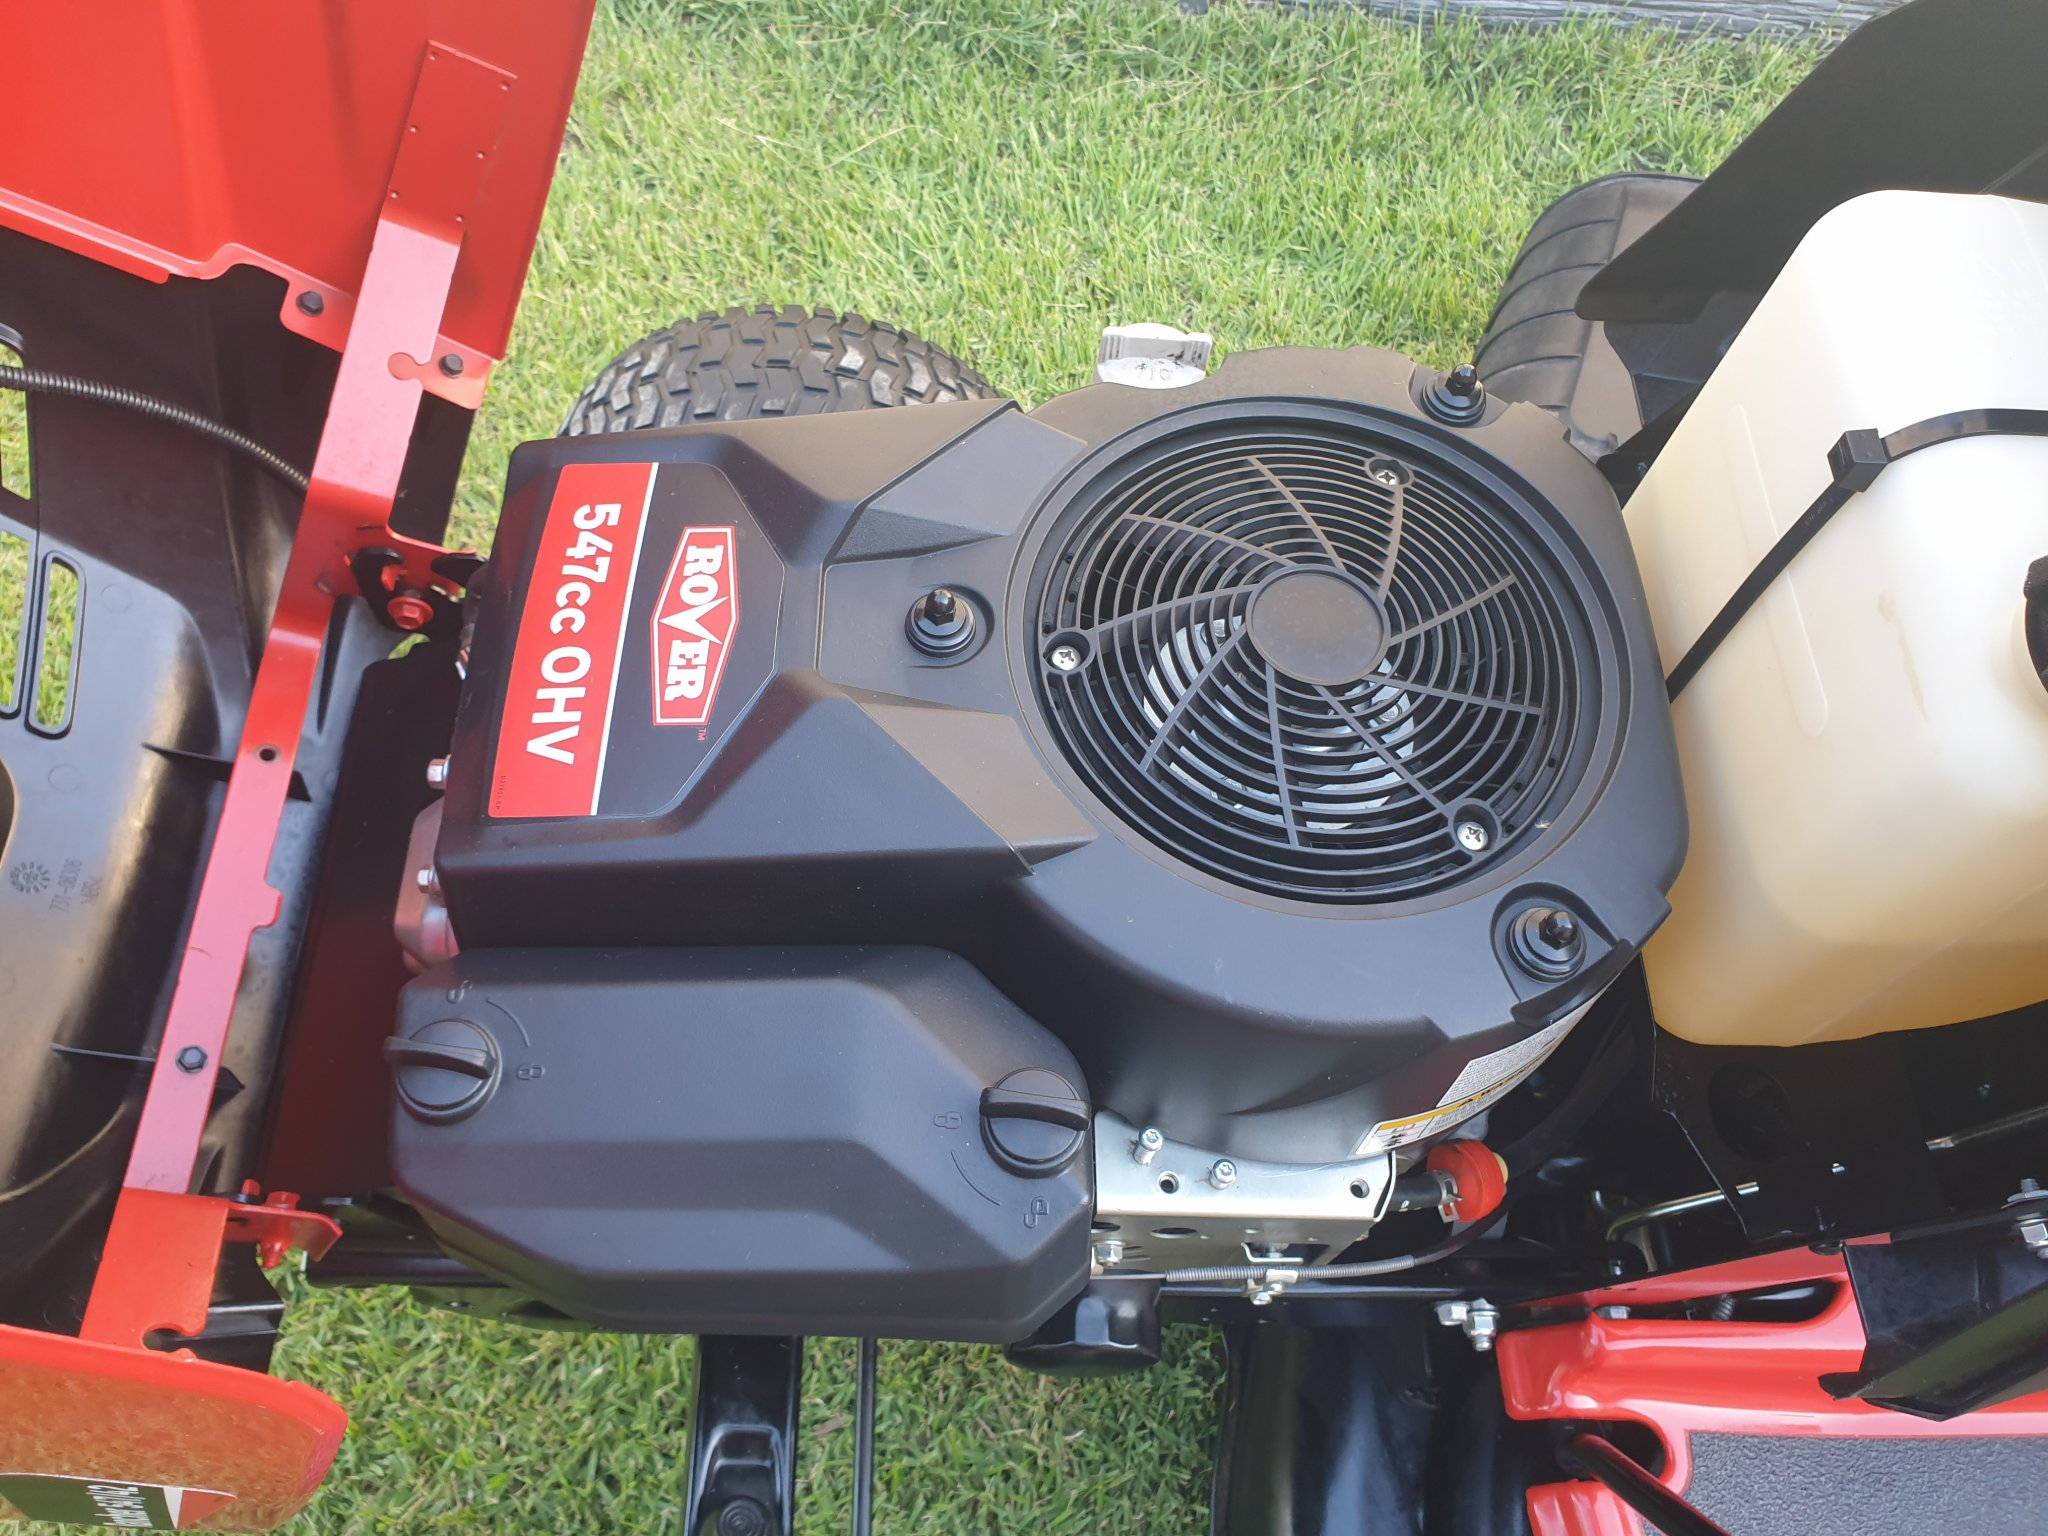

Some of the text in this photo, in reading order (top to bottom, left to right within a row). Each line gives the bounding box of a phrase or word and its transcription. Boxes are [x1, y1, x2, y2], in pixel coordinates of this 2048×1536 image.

[526, 503, 622, 765] 547cc OHV
[659, 544, 729, 701] ROVER
